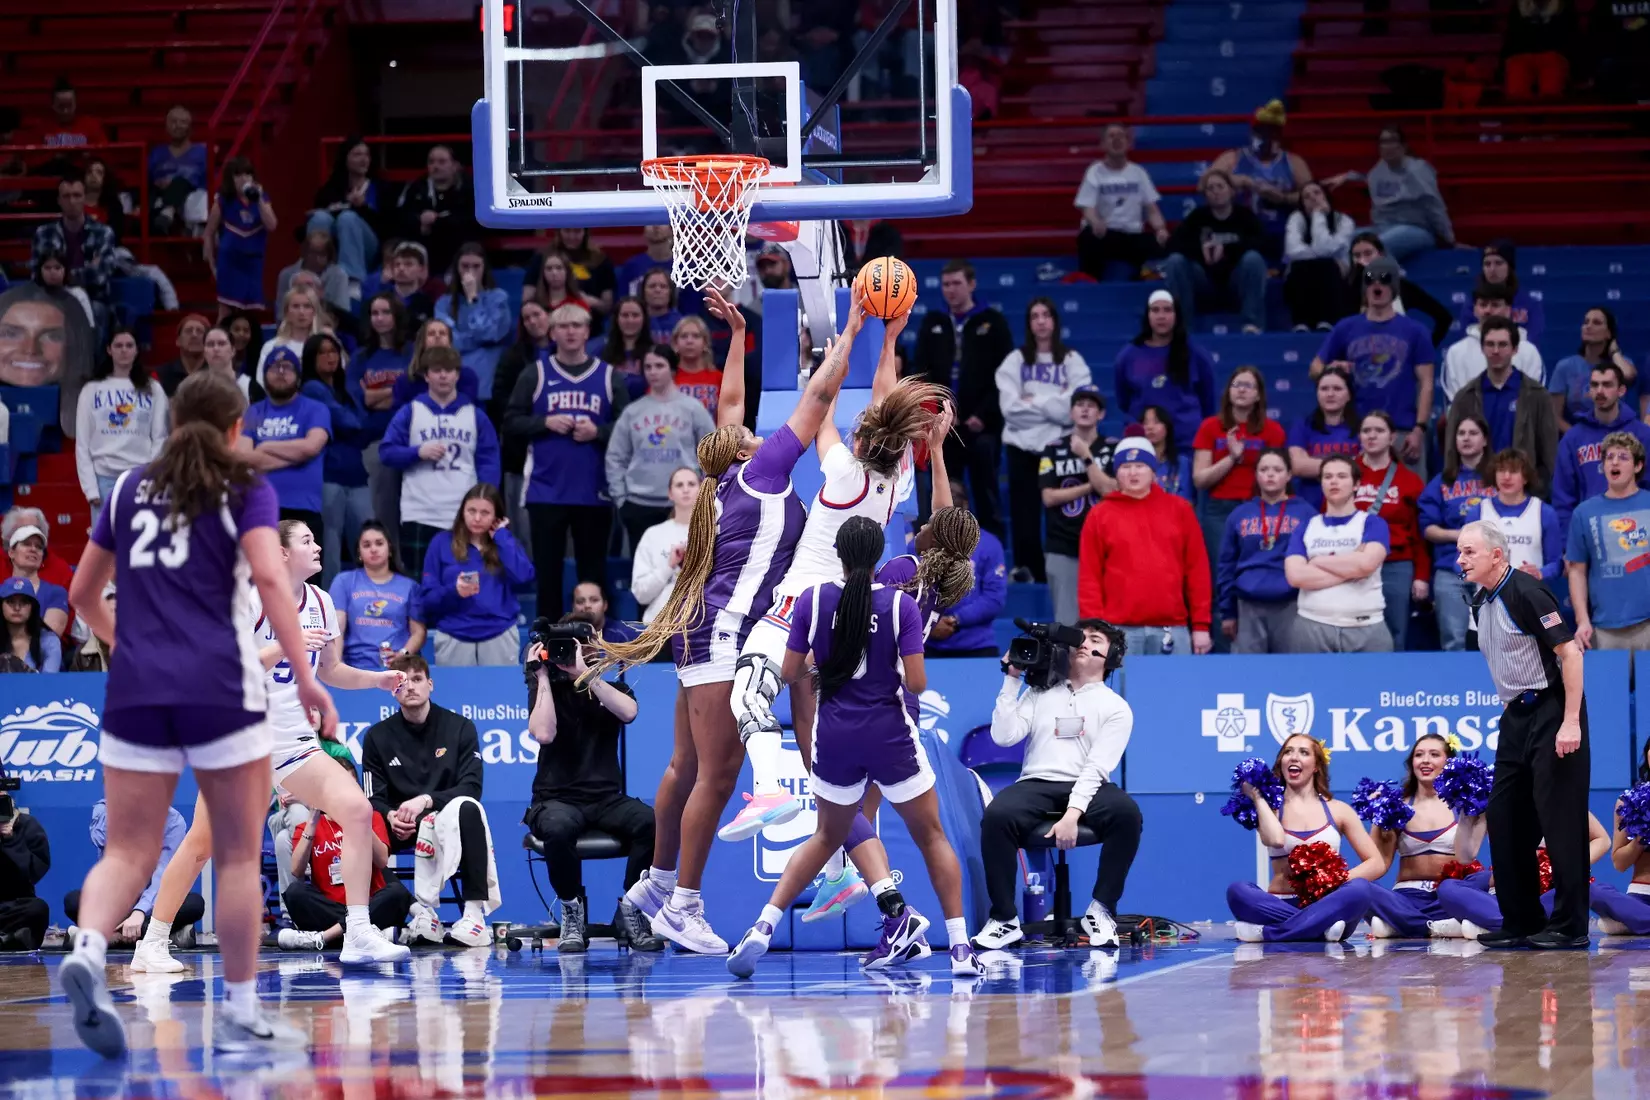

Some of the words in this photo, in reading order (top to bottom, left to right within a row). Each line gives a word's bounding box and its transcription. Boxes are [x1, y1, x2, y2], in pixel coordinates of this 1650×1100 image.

[508, 196, 553, 209] SPALDING
[872, 263, 883, 293] NCAA
[891, 260, 904, 299] Wilson
[94, 388, 153, 409] KANSAS
[420, 427, 472, 443] KANSAS
[129, 508, 190, 569] 23
[1379, 691, 1460, 707] BlueCross
[1465, 690, 1503, 706] Blue
[462, 704, 530, 720] BlueShie
[1327, 707, 1501, 752] Kans
[1194, 792, 1205, 804] 9
[314, 836, 344, 858] KAN
